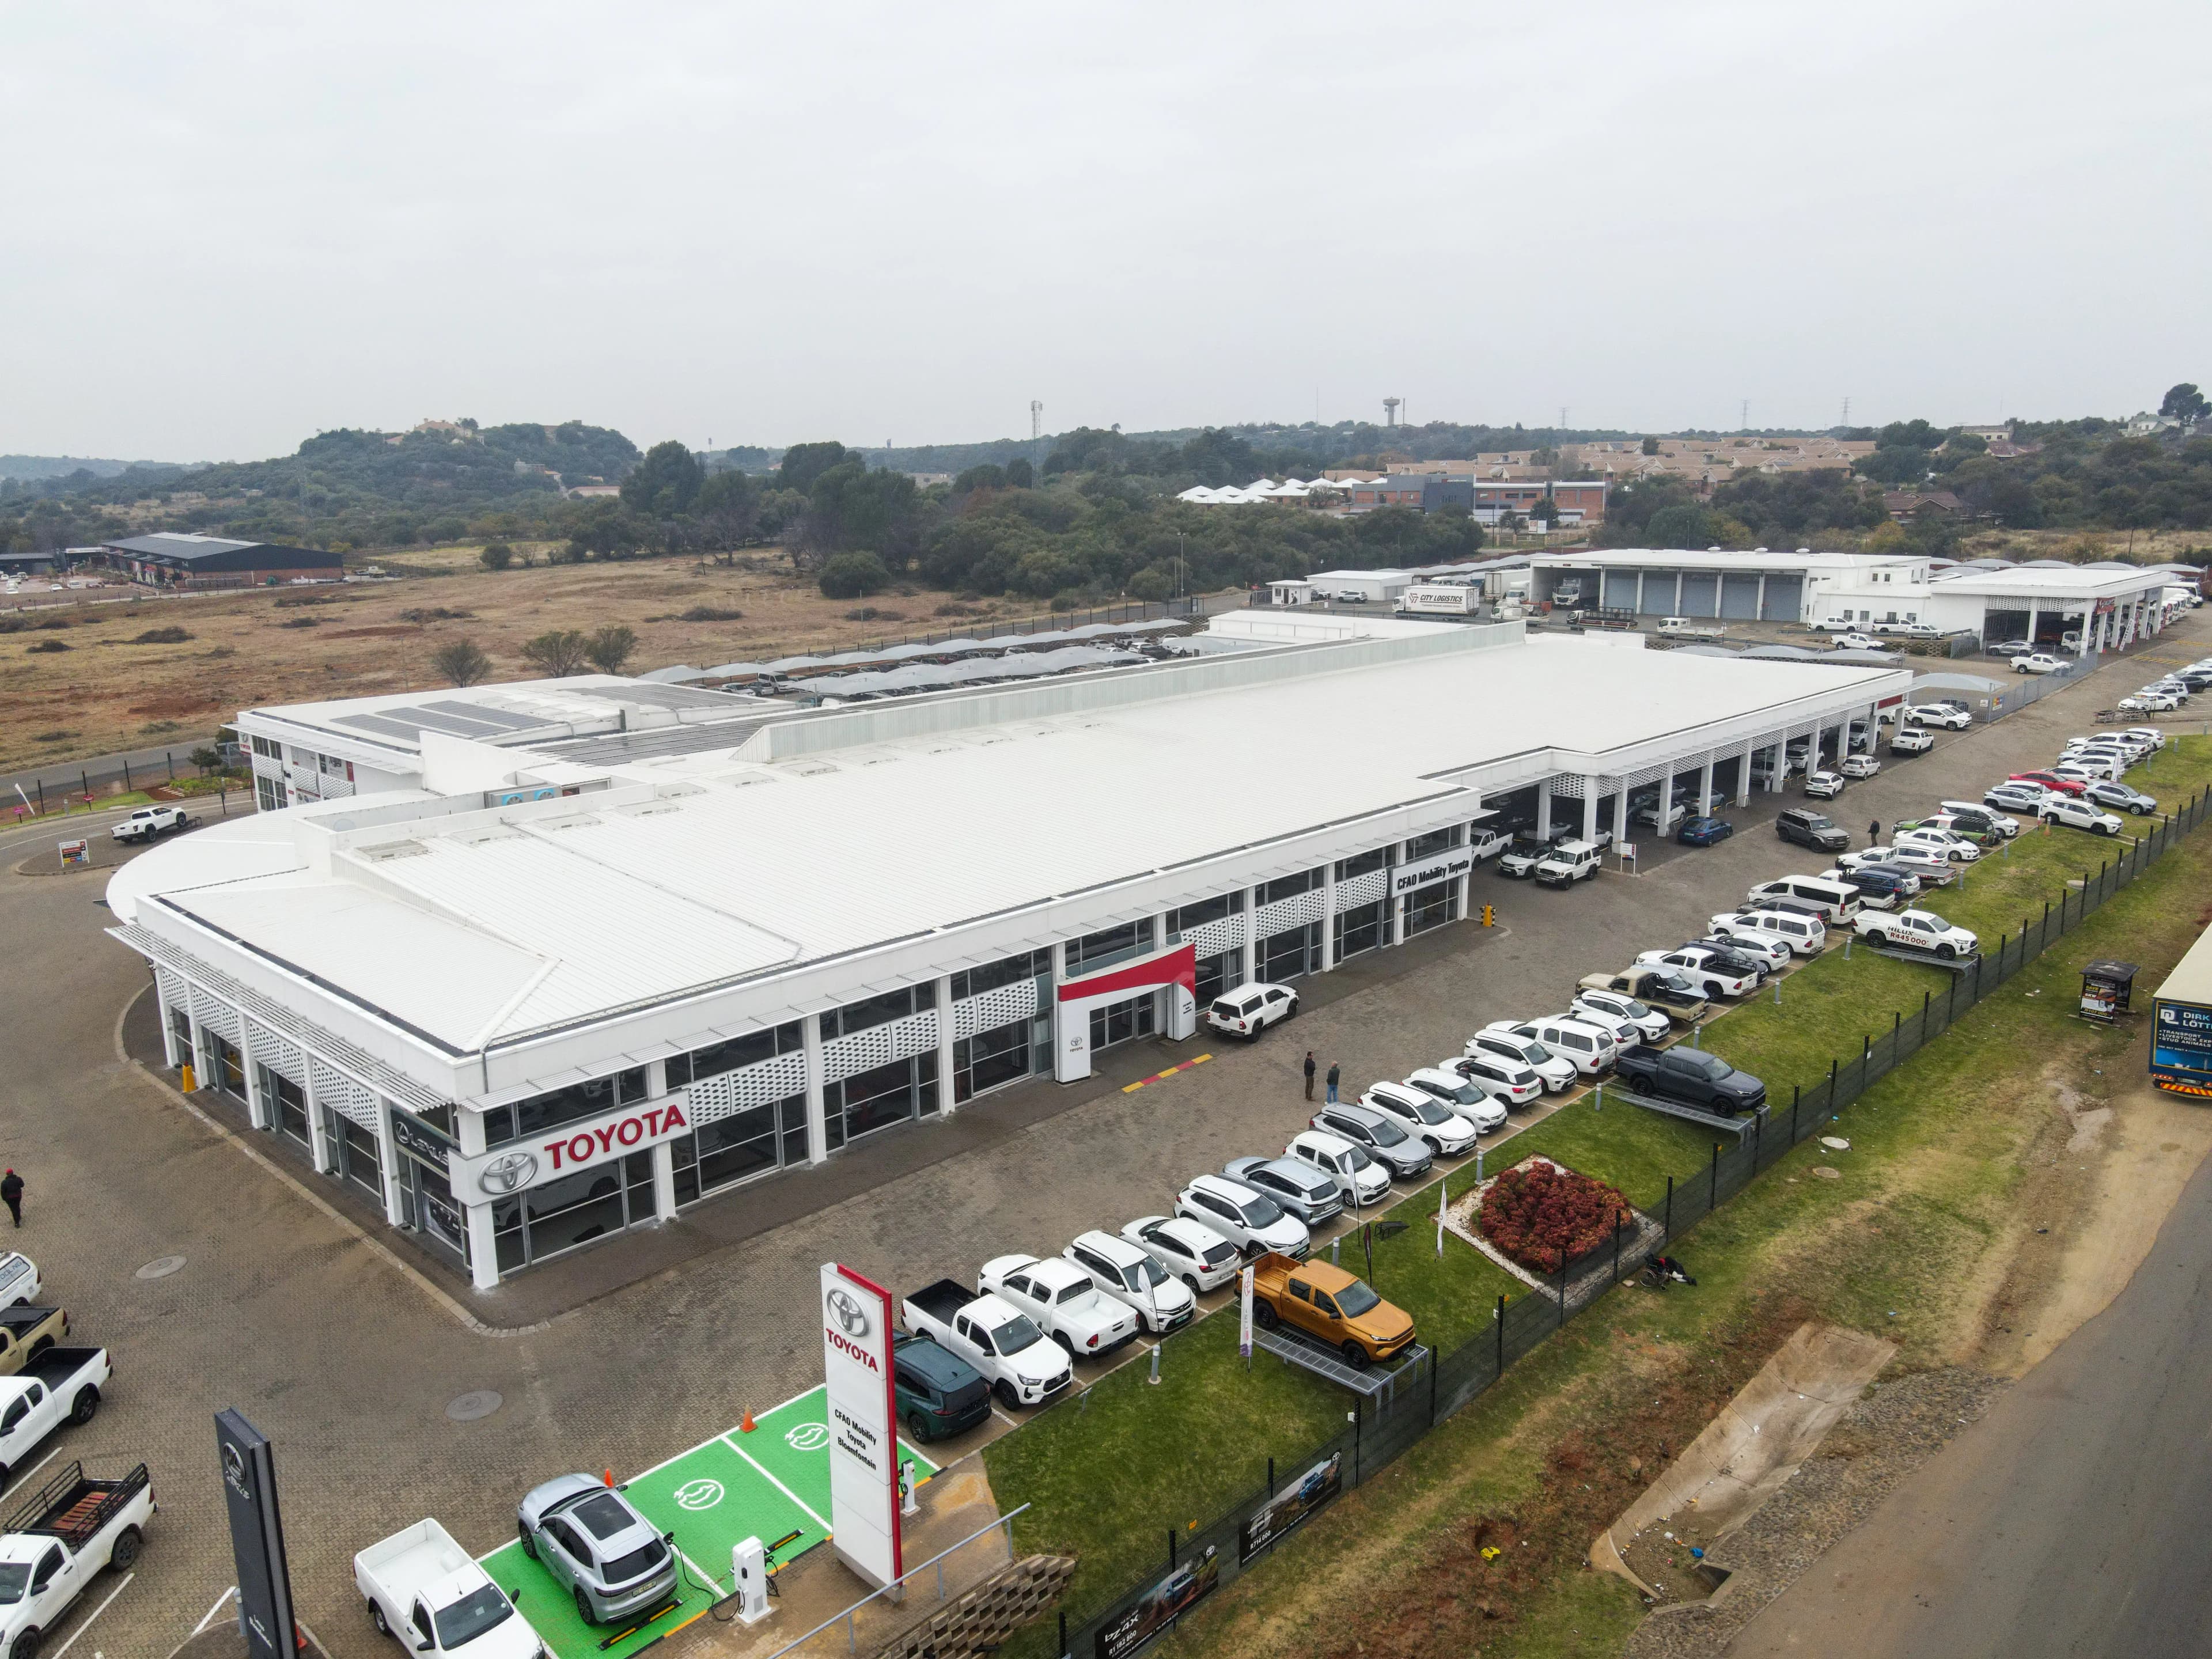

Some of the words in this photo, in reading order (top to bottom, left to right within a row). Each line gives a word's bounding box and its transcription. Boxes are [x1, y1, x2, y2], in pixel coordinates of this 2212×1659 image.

[1397, 874, 1417, 890] CFAO
[1418, 866, 1447, 884] Mobility
[1448, 859, 1469, 874] Toyota
[1887, 926, 1915, 936] HILUX
[2183, 1012, 2210, 1021] DIRK
[2183, 1020, 2212, 1029] LÖTT
[2162, 1029, 2201, 1039] TRANSPORT
[2162, 1033, 2197, 1042] LIVESTOCK
[2181, 1040, 2211, 1048] ANIMALS
[544, 1104, 687, 1170] TOYOTA
[825, 1328, 878, 1373] TOYOTA
[835, 1409, 851, 1426] CFAO
[852, 1421, 877, 1445] Mobility
[846, 1429, 866, 1450] Toyota
[838, 1437, 877, 1471] Bloemfontein
[1250, 1537, 1262, 1550] R714
[1262, 1530, 1271, 1541] 000
[1126, 1630, 1137, 1642] 800
